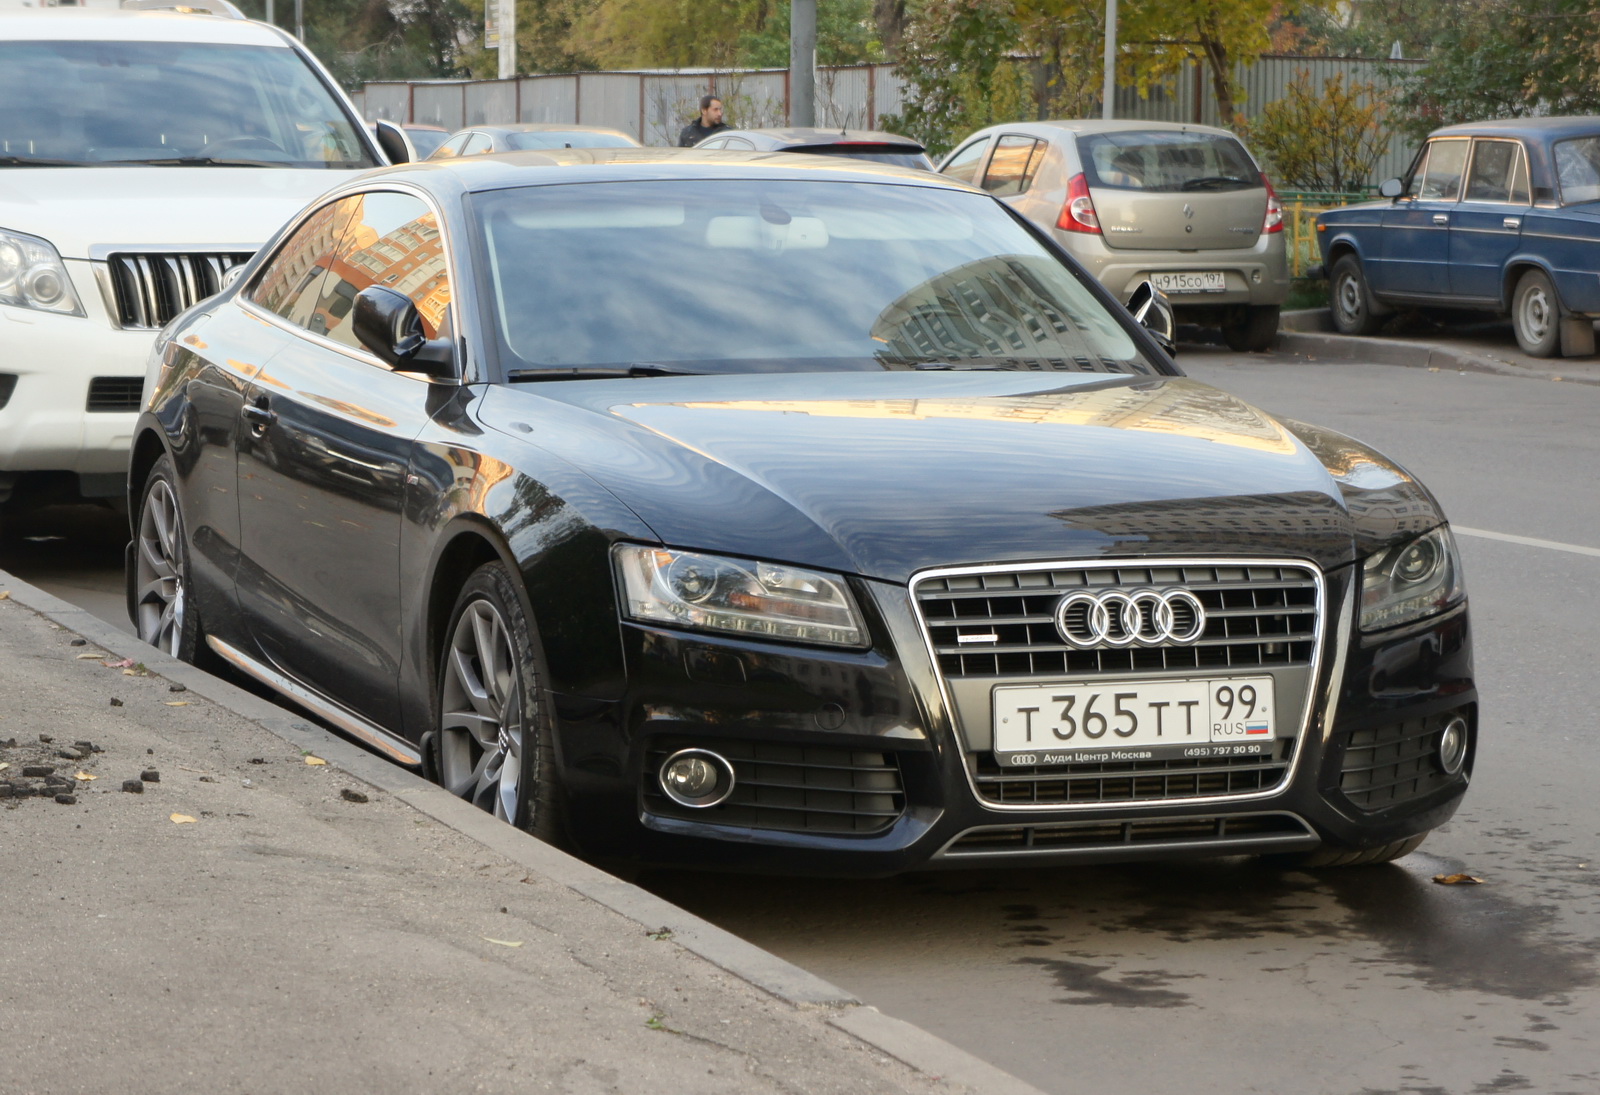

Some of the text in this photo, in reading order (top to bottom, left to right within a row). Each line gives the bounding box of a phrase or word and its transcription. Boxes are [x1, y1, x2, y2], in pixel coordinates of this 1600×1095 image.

[1215, 684, 1257, 720] 99
[1213, 722, 1244, 736] RUS
[1043, 751, 1152, 763] Ауди Центр Москва
[1184, 744, 1261, 757] (495) 797 90 90
